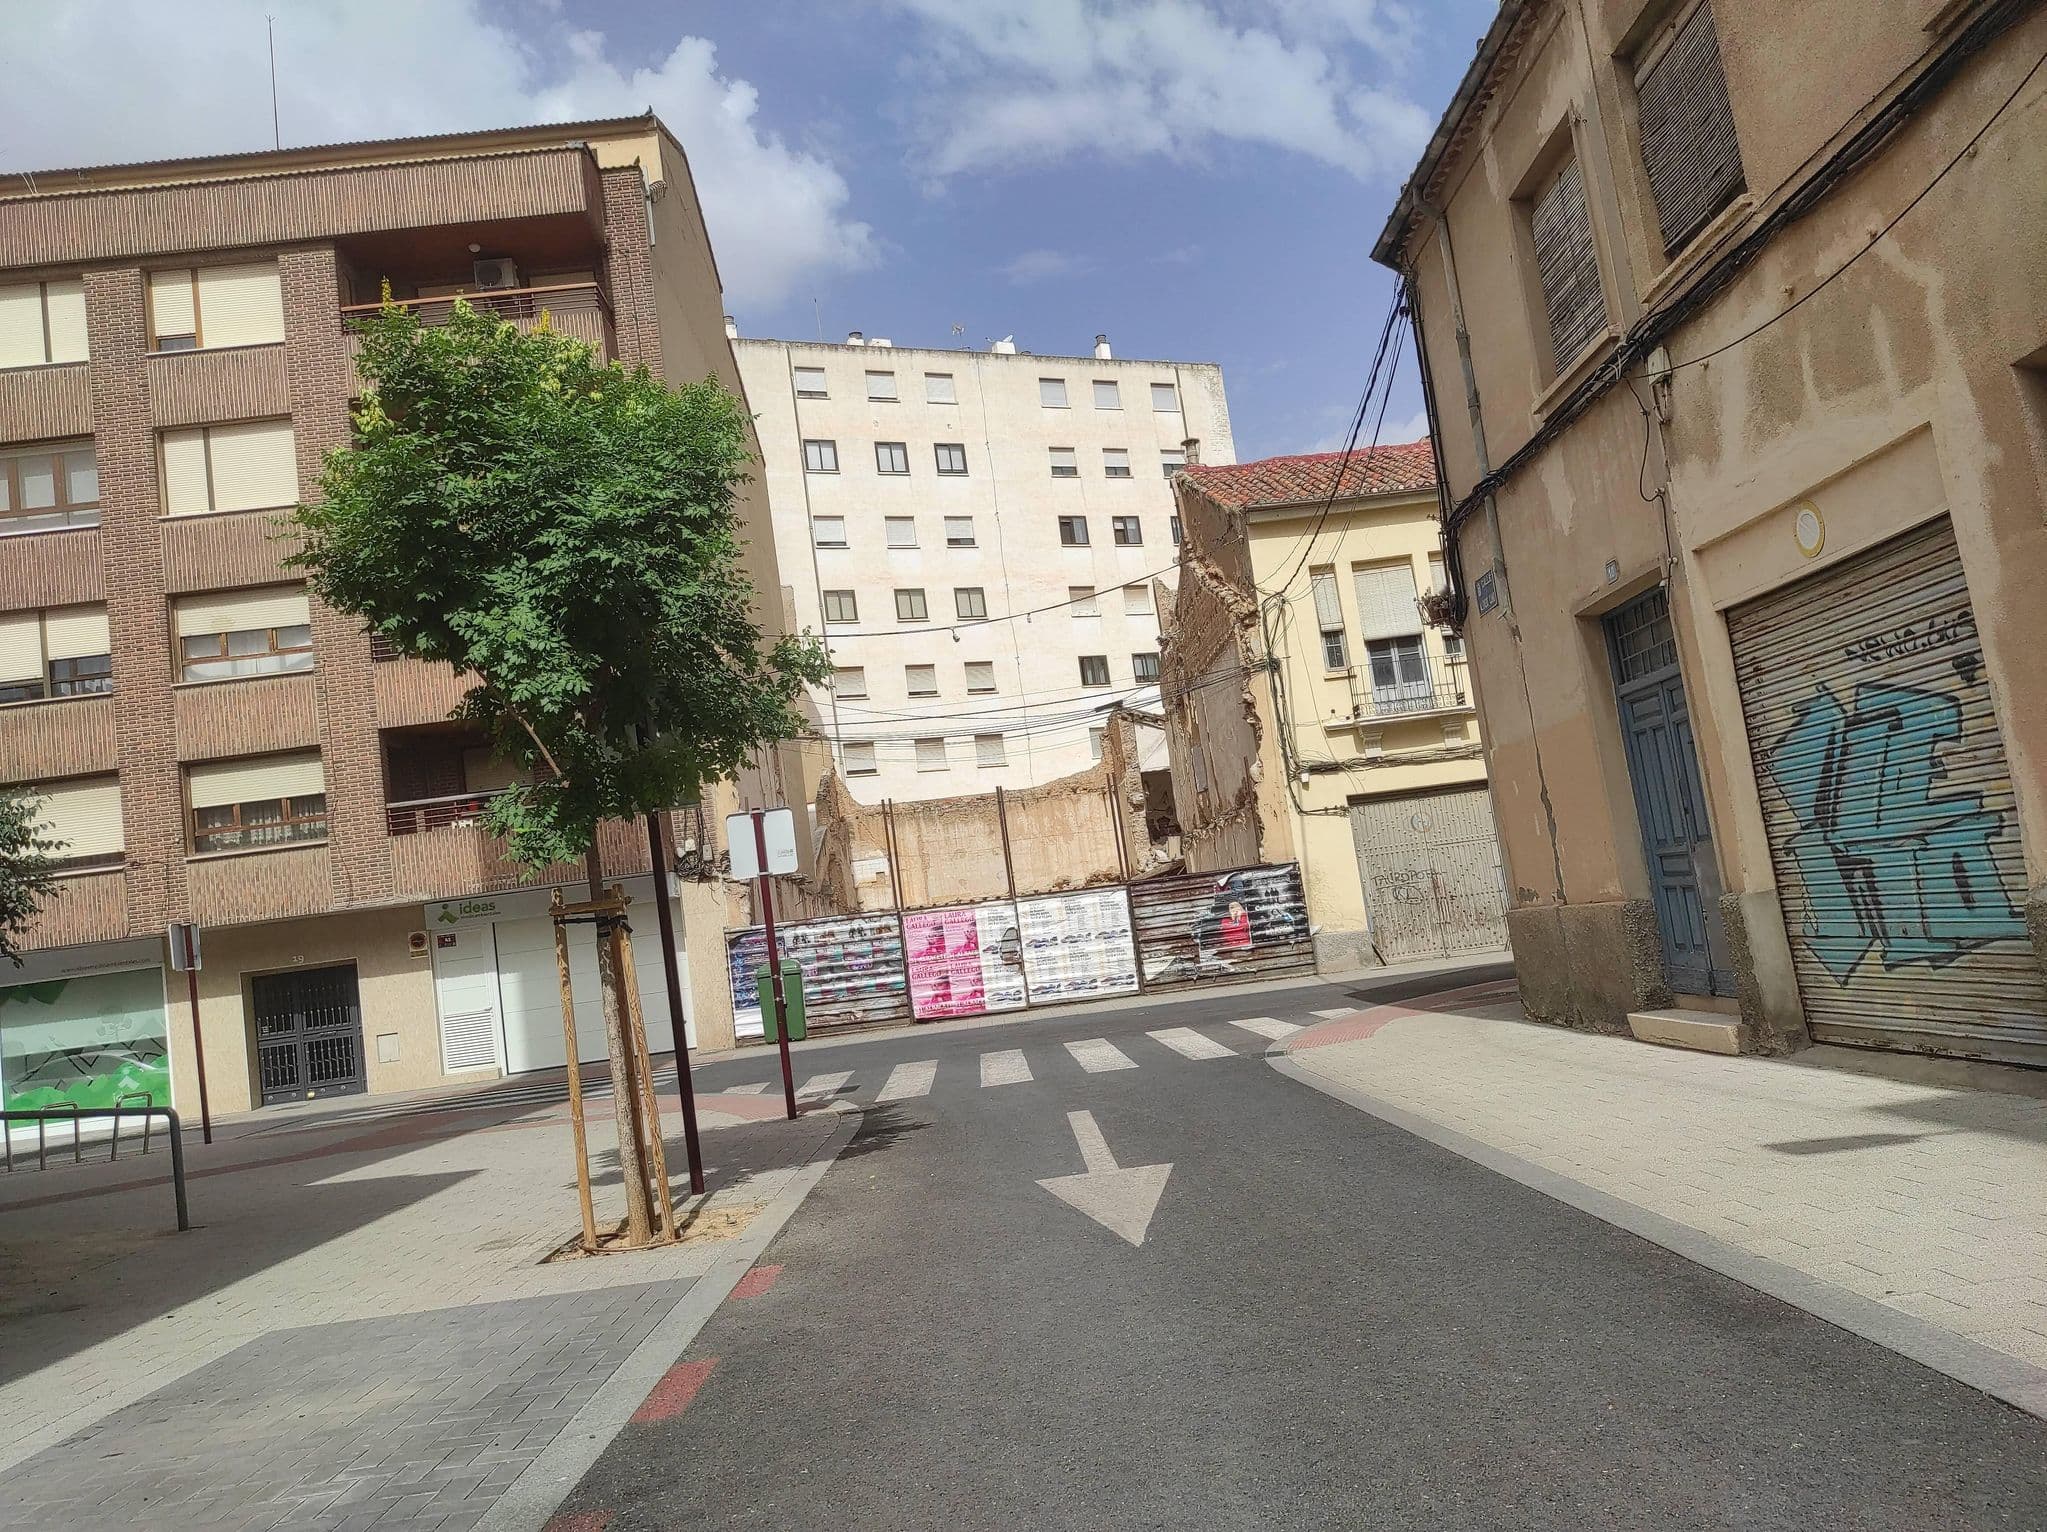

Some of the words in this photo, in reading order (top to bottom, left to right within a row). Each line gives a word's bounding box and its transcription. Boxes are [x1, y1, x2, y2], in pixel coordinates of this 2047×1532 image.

[459, 901, 496, 914] ideas
[944, 911, 967, 919] LAURA
[911, 970, 942, 980] GALLEGO
[950, 965, 980, 975] GALLEGO
